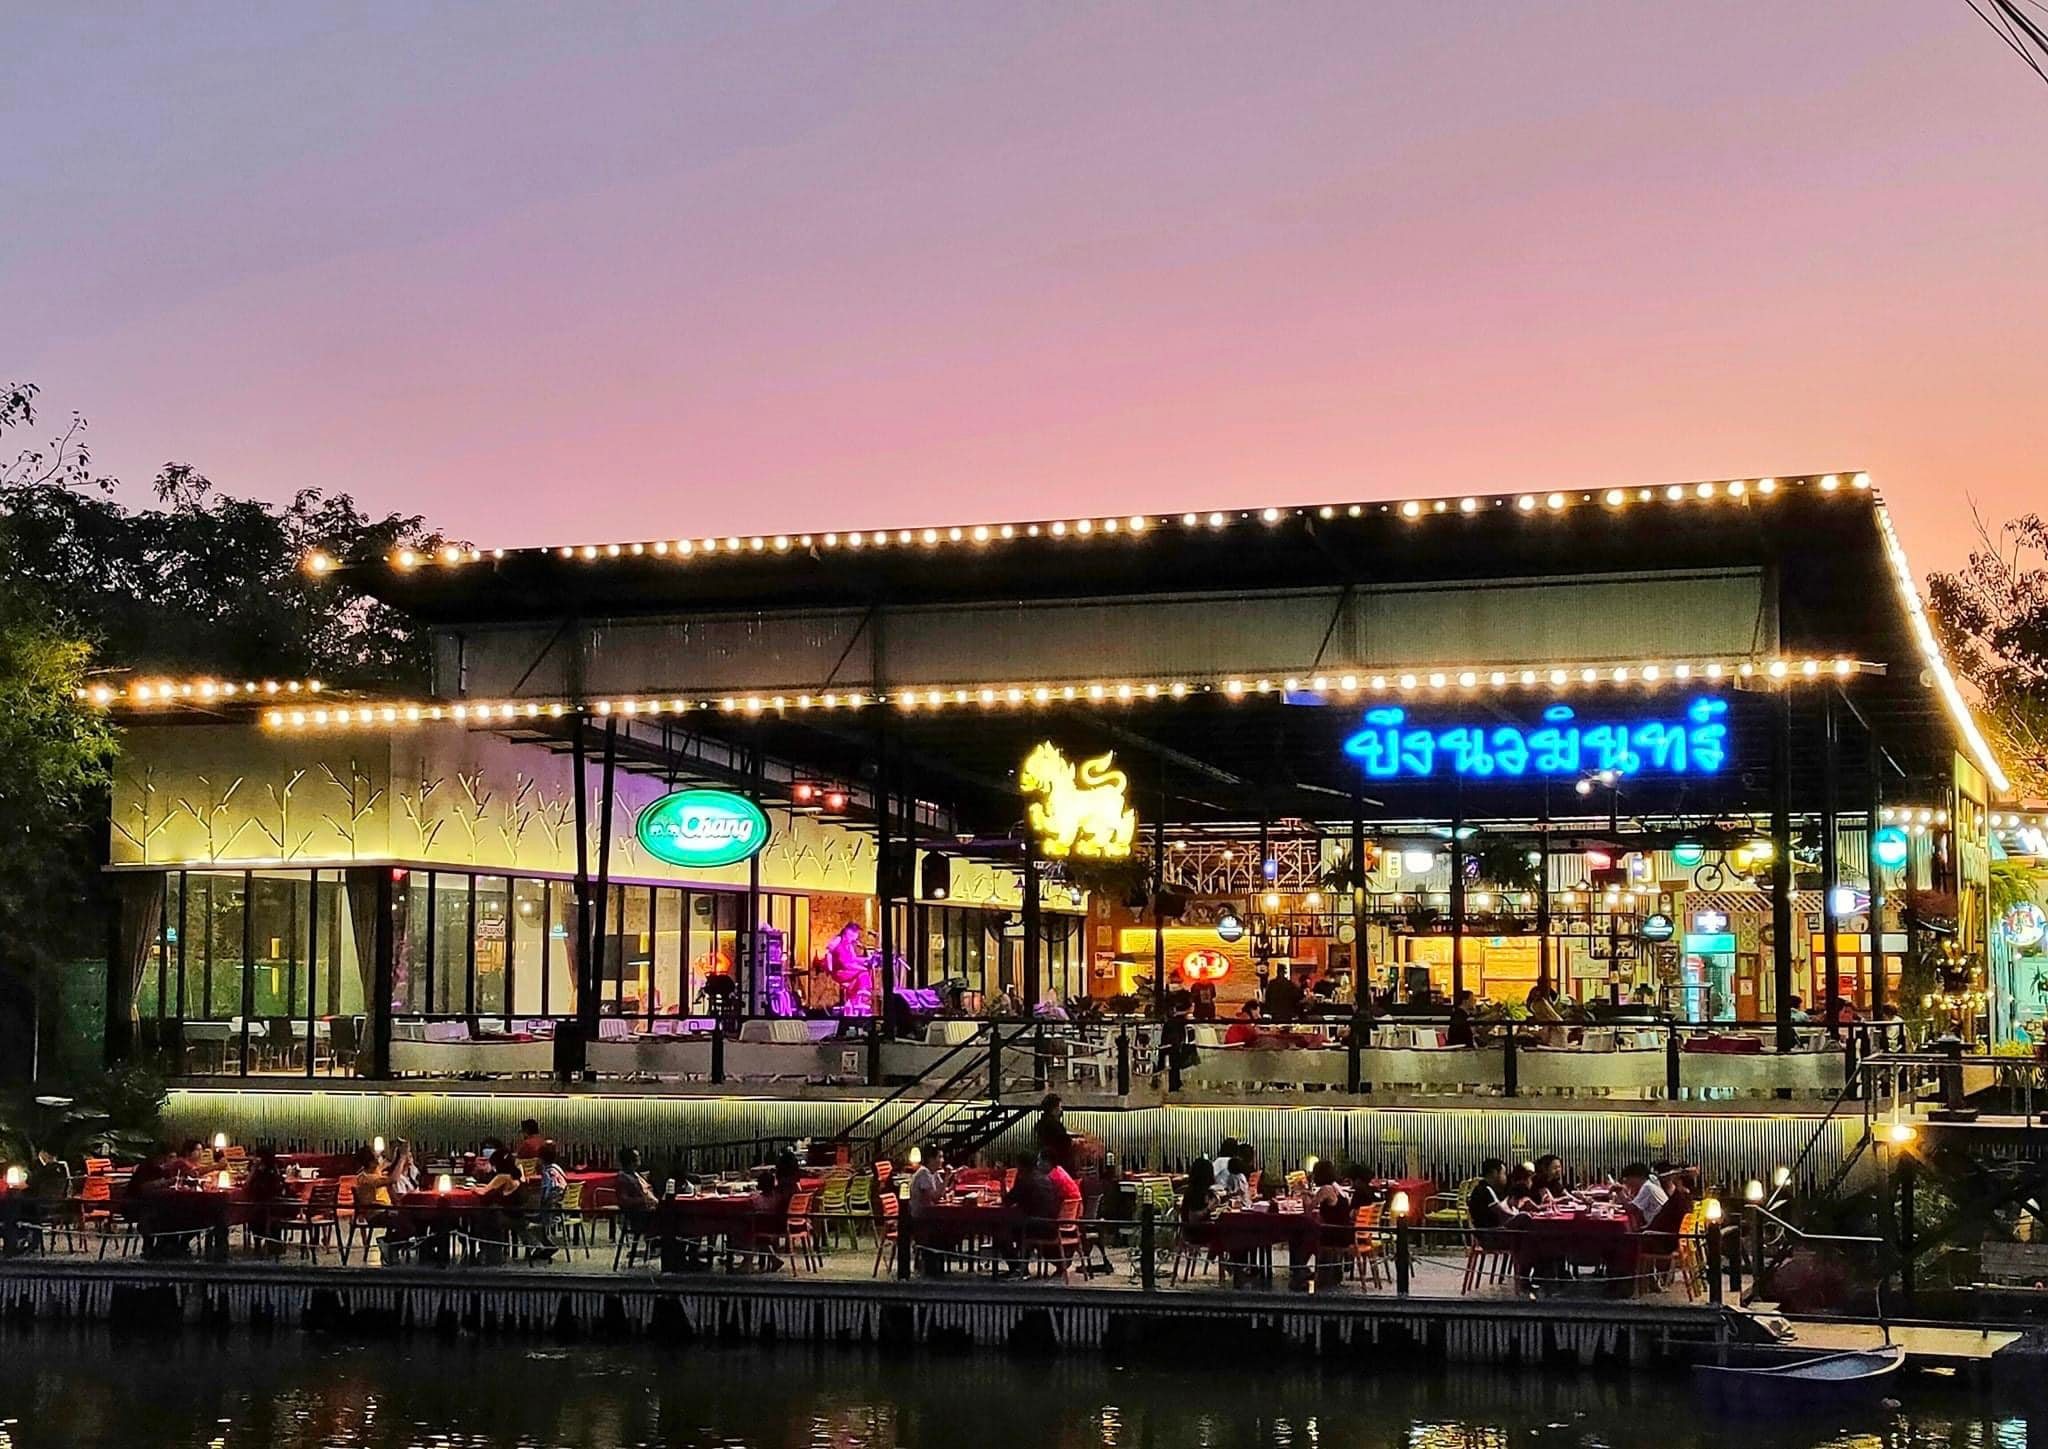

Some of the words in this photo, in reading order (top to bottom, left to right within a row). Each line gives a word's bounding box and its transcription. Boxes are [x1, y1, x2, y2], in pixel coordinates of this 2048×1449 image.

[1344, 697, 1728, 775] บึงนวมินทร์
